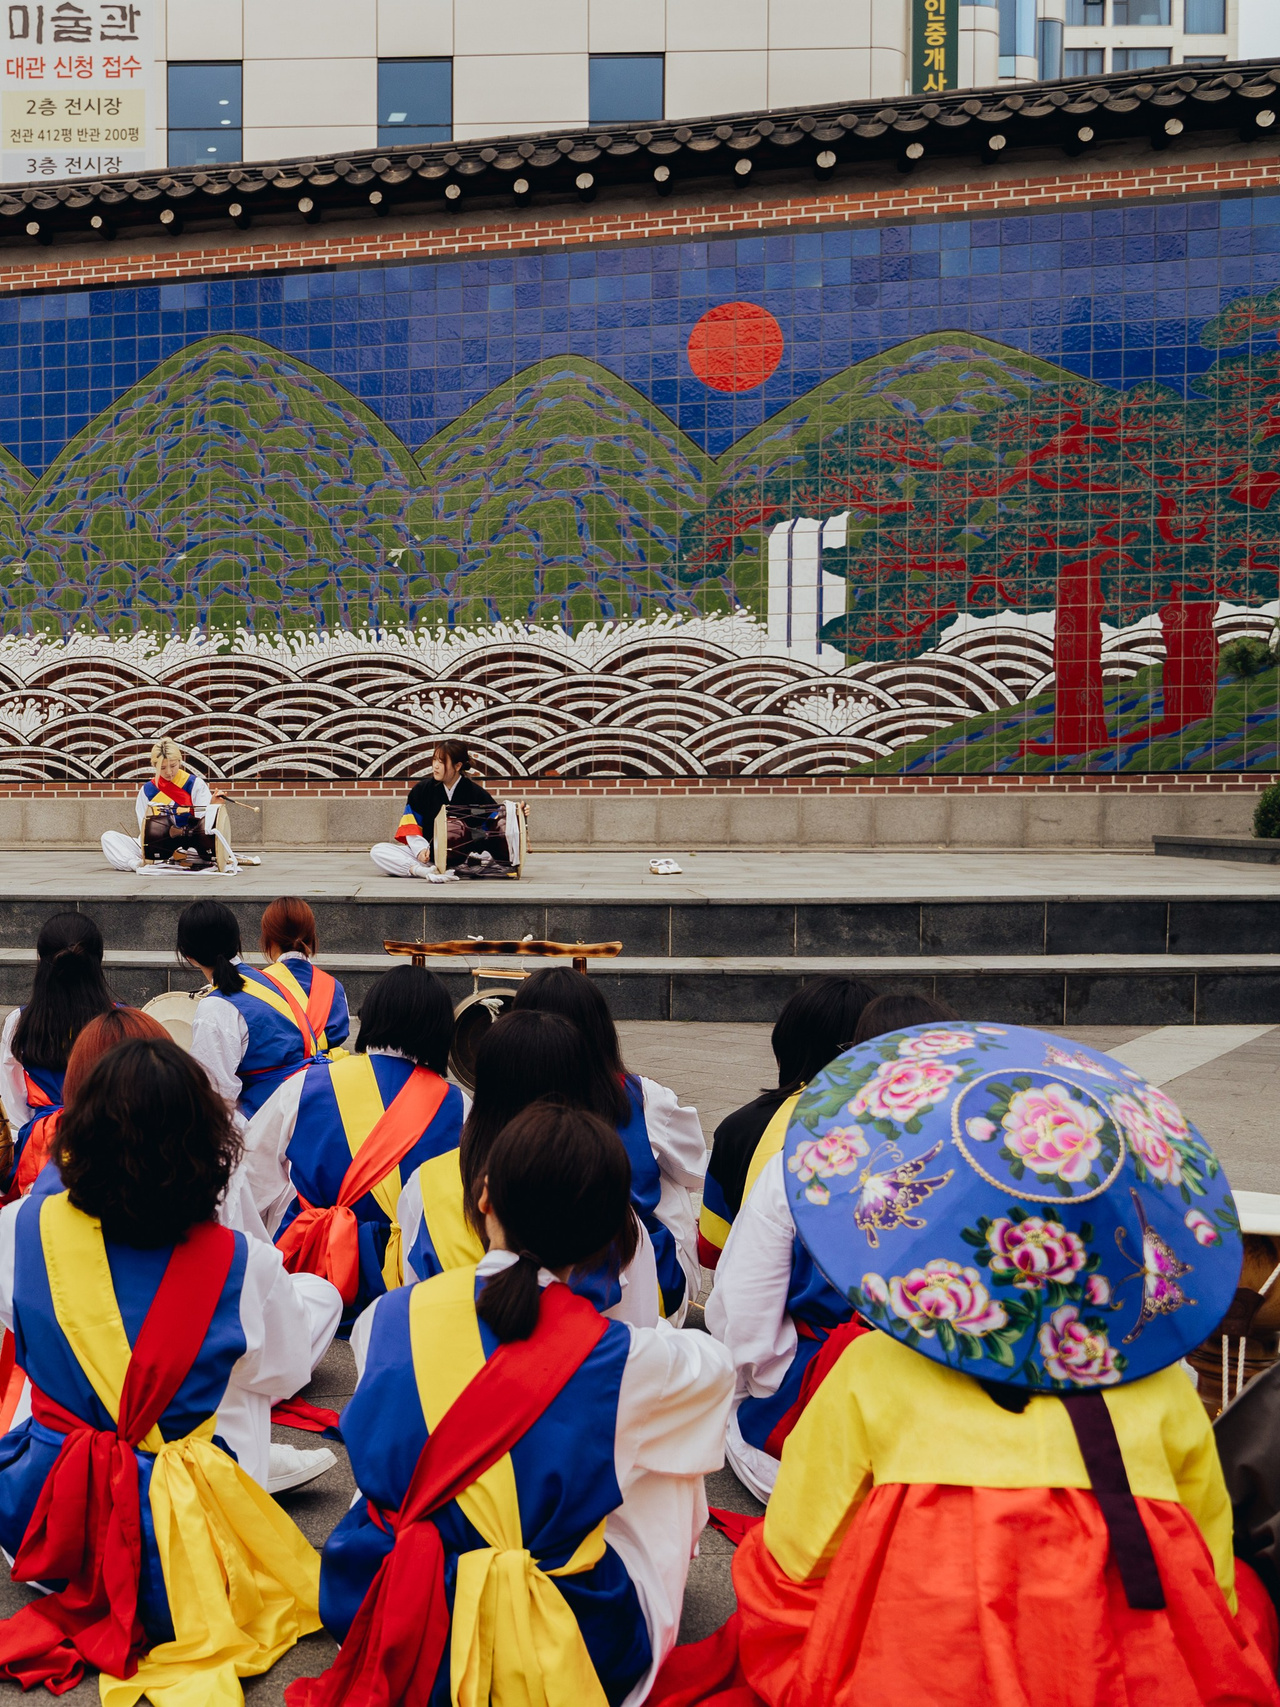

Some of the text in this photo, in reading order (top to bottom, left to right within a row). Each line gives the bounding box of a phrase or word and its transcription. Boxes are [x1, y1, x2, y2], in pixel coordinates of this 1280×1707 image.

[8, 2, 142, 45] 미술관
[6, 55, 142, 80] 대관 신청 접수
[26, 97, 123, 117] 2층 전시장
[10, 127, 140, 144] 전관 412평 반관 200평
[26, 156, 123, 176] 3층 전시장
